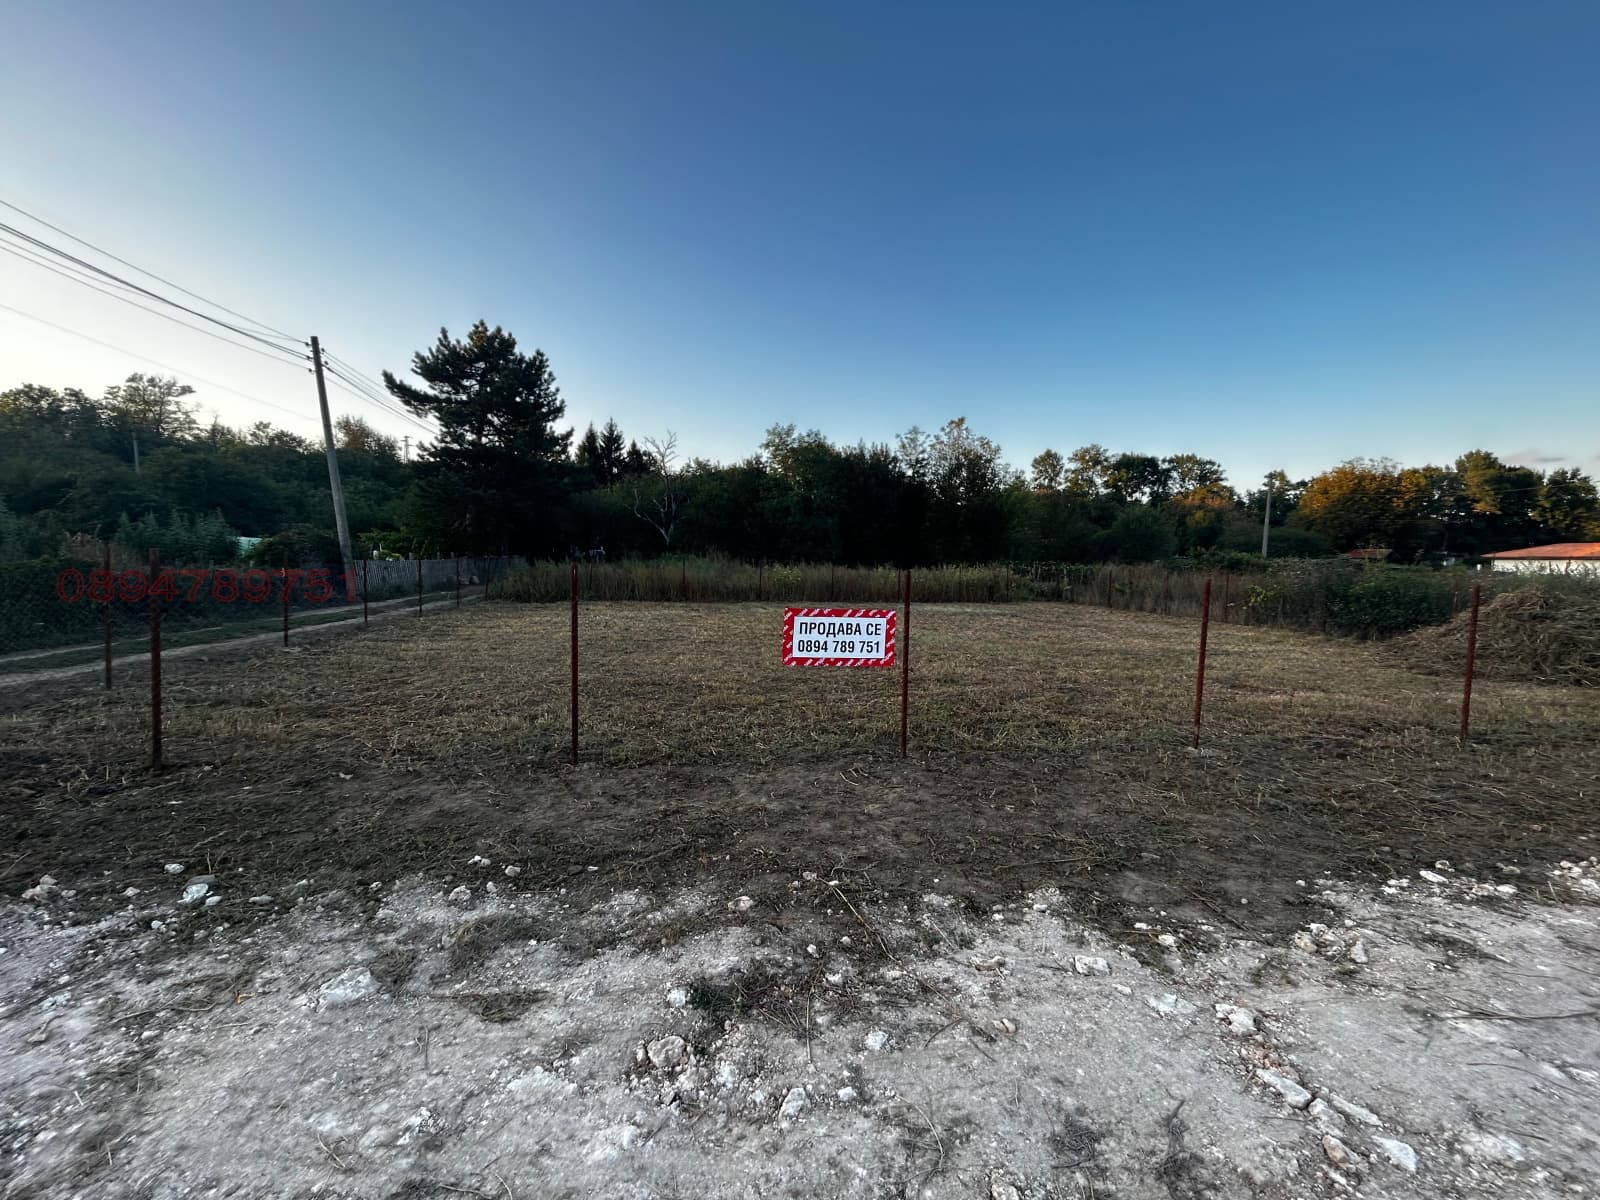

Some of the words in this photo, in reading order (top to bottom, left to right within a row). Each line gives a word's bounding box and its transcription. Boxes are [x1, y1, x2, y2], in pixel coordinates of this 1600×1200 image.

[799, 622, 862, 638] ПРОДАВА
[866, 623, 882, 636] СЕ
[798, 640, 828, 653] 0894
[833, 641, 855, 653] 789
[859, 641, 880, 654] 751
